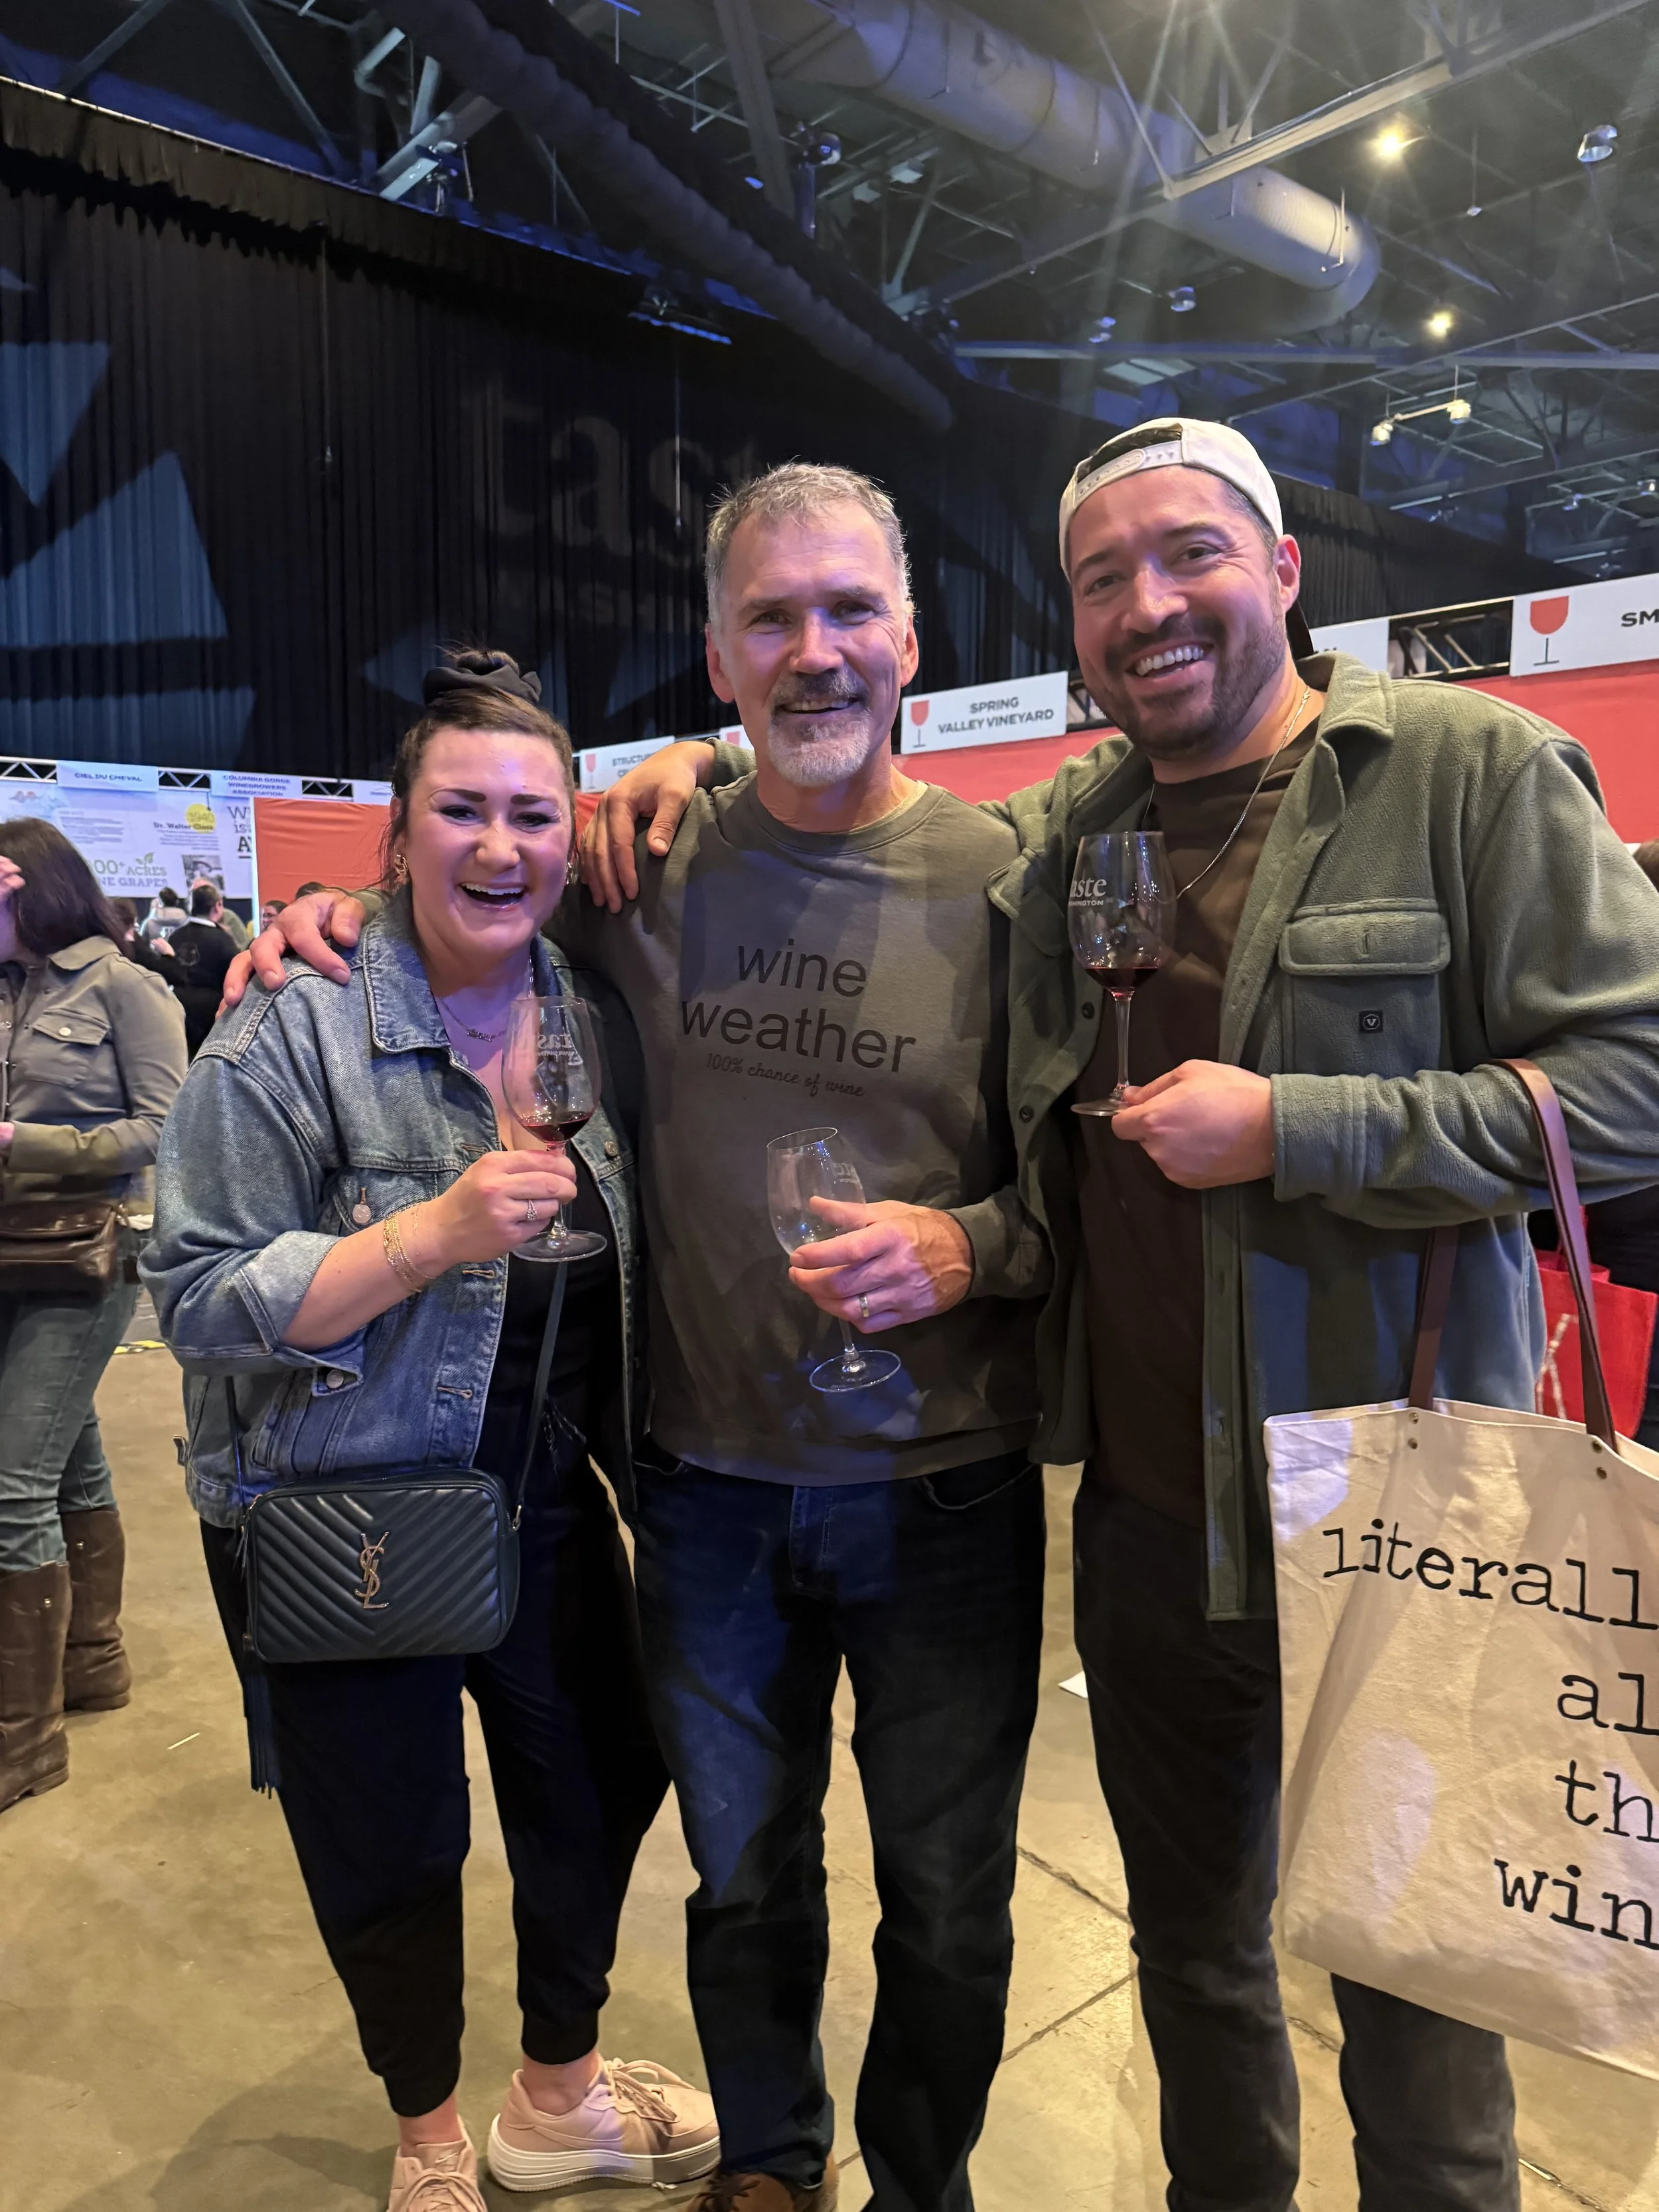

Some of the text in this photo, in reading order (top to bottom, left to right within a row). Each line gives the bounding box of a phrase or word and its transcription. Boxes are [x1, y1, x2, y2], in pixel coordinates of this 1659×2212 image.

[938, 709, 1054, 734] VALLEY VINEYARD
[970, 697, 1019, 713] SPRING
[127, 866, 167, 876] ACRES
[738, 938, 866, 996] wine
[681, 1001, 916, 1072] weather
[707, 1053, 866, 1097] 100% chance of wine
[1323, 1518, 1659, 1631] literall
[1556, 1672, 1659, 1736] al
[1555, 1759, 1659, 1843] th
[1494, 1858, 1659, 1951] win
